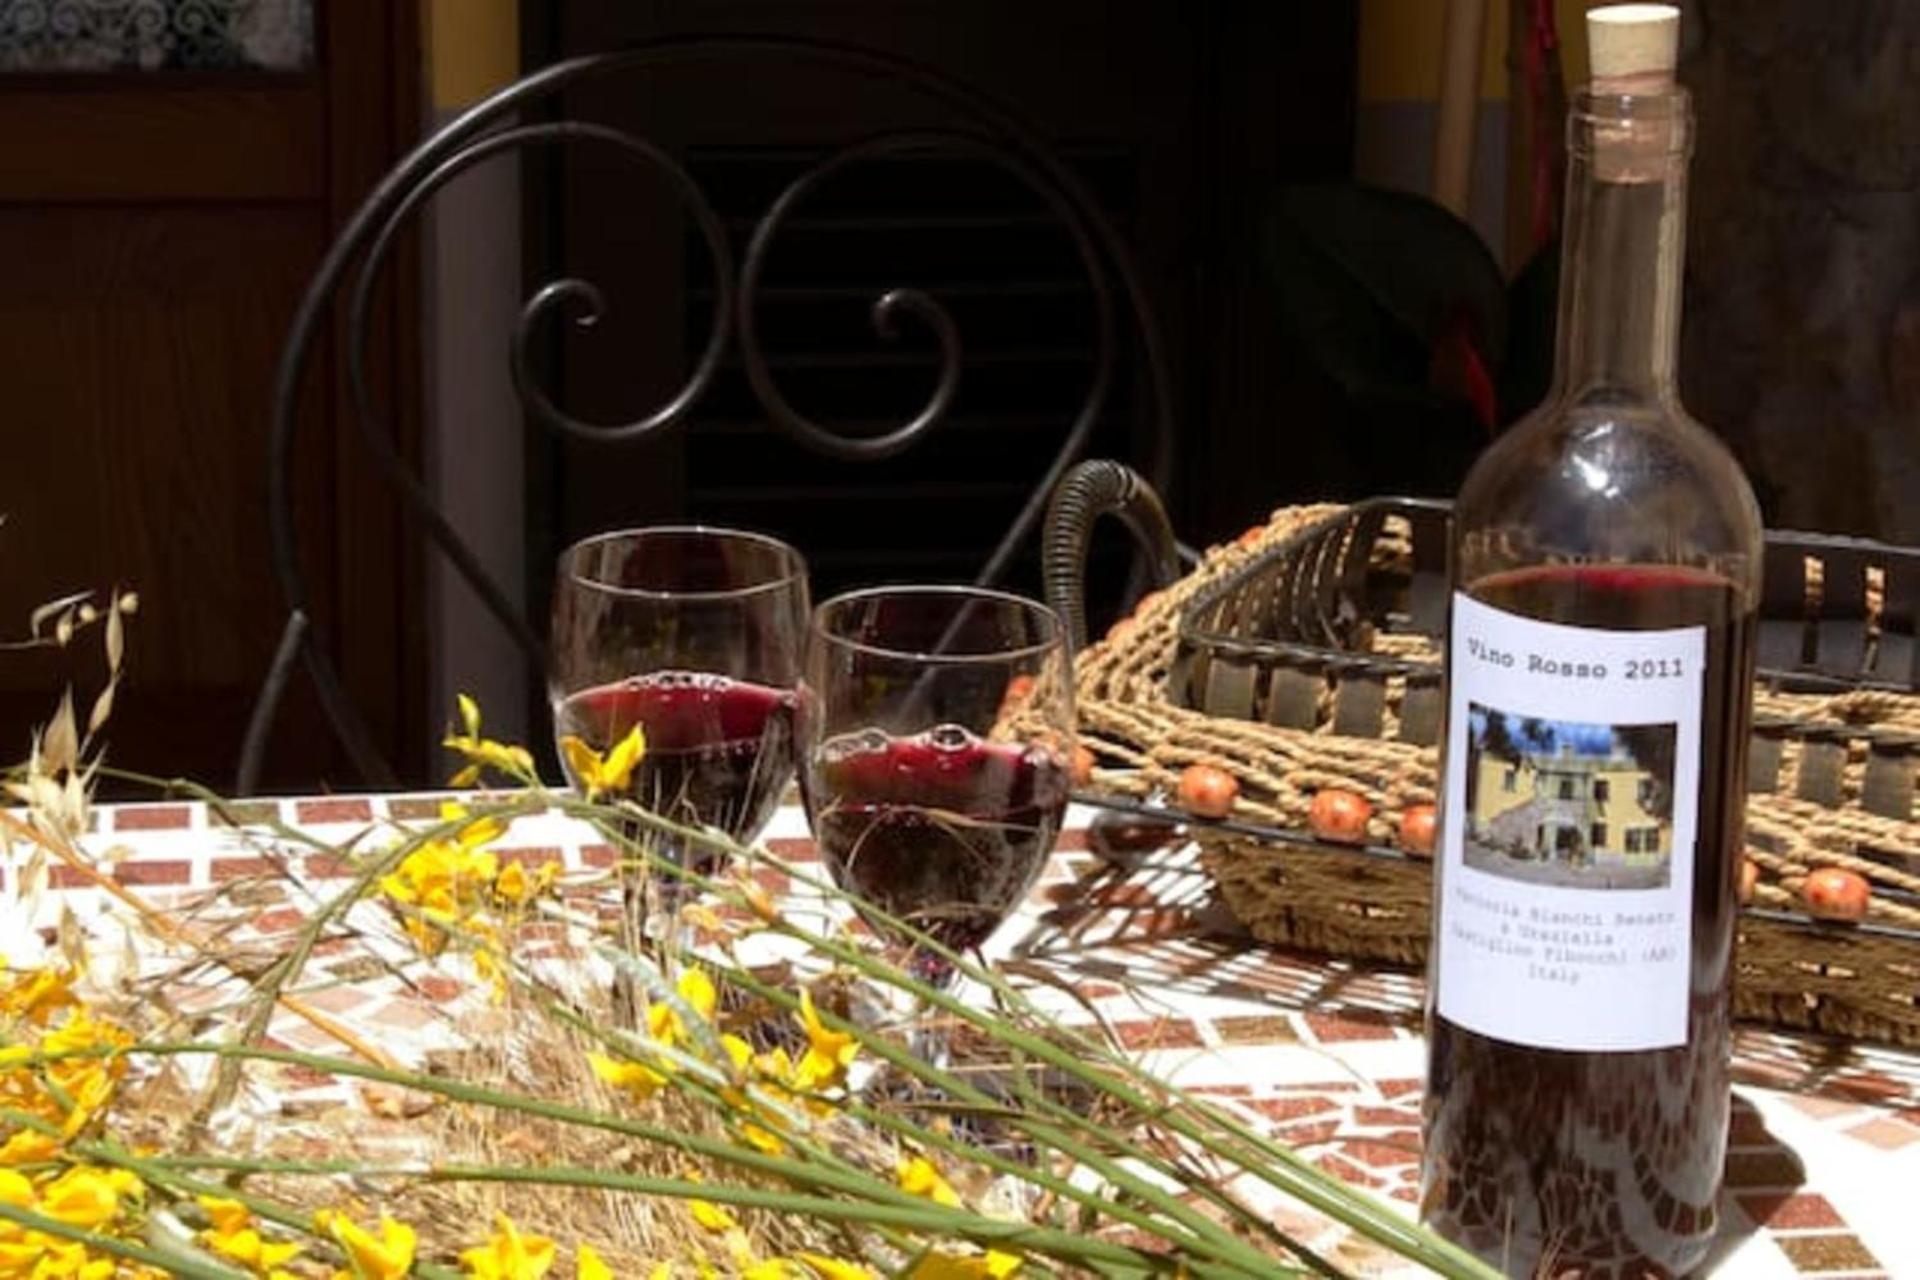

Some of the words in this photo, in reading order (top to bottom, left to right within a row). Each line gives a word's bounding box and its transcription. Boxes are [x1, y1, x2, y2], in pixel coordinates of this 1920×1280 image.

[1467, 637, 1514, 668] Vino
[1528, 653, 1608, 679] Rosso
[1624, 658, 1683, 680] 2011
[1528, 962, 1579, 987] Italy
